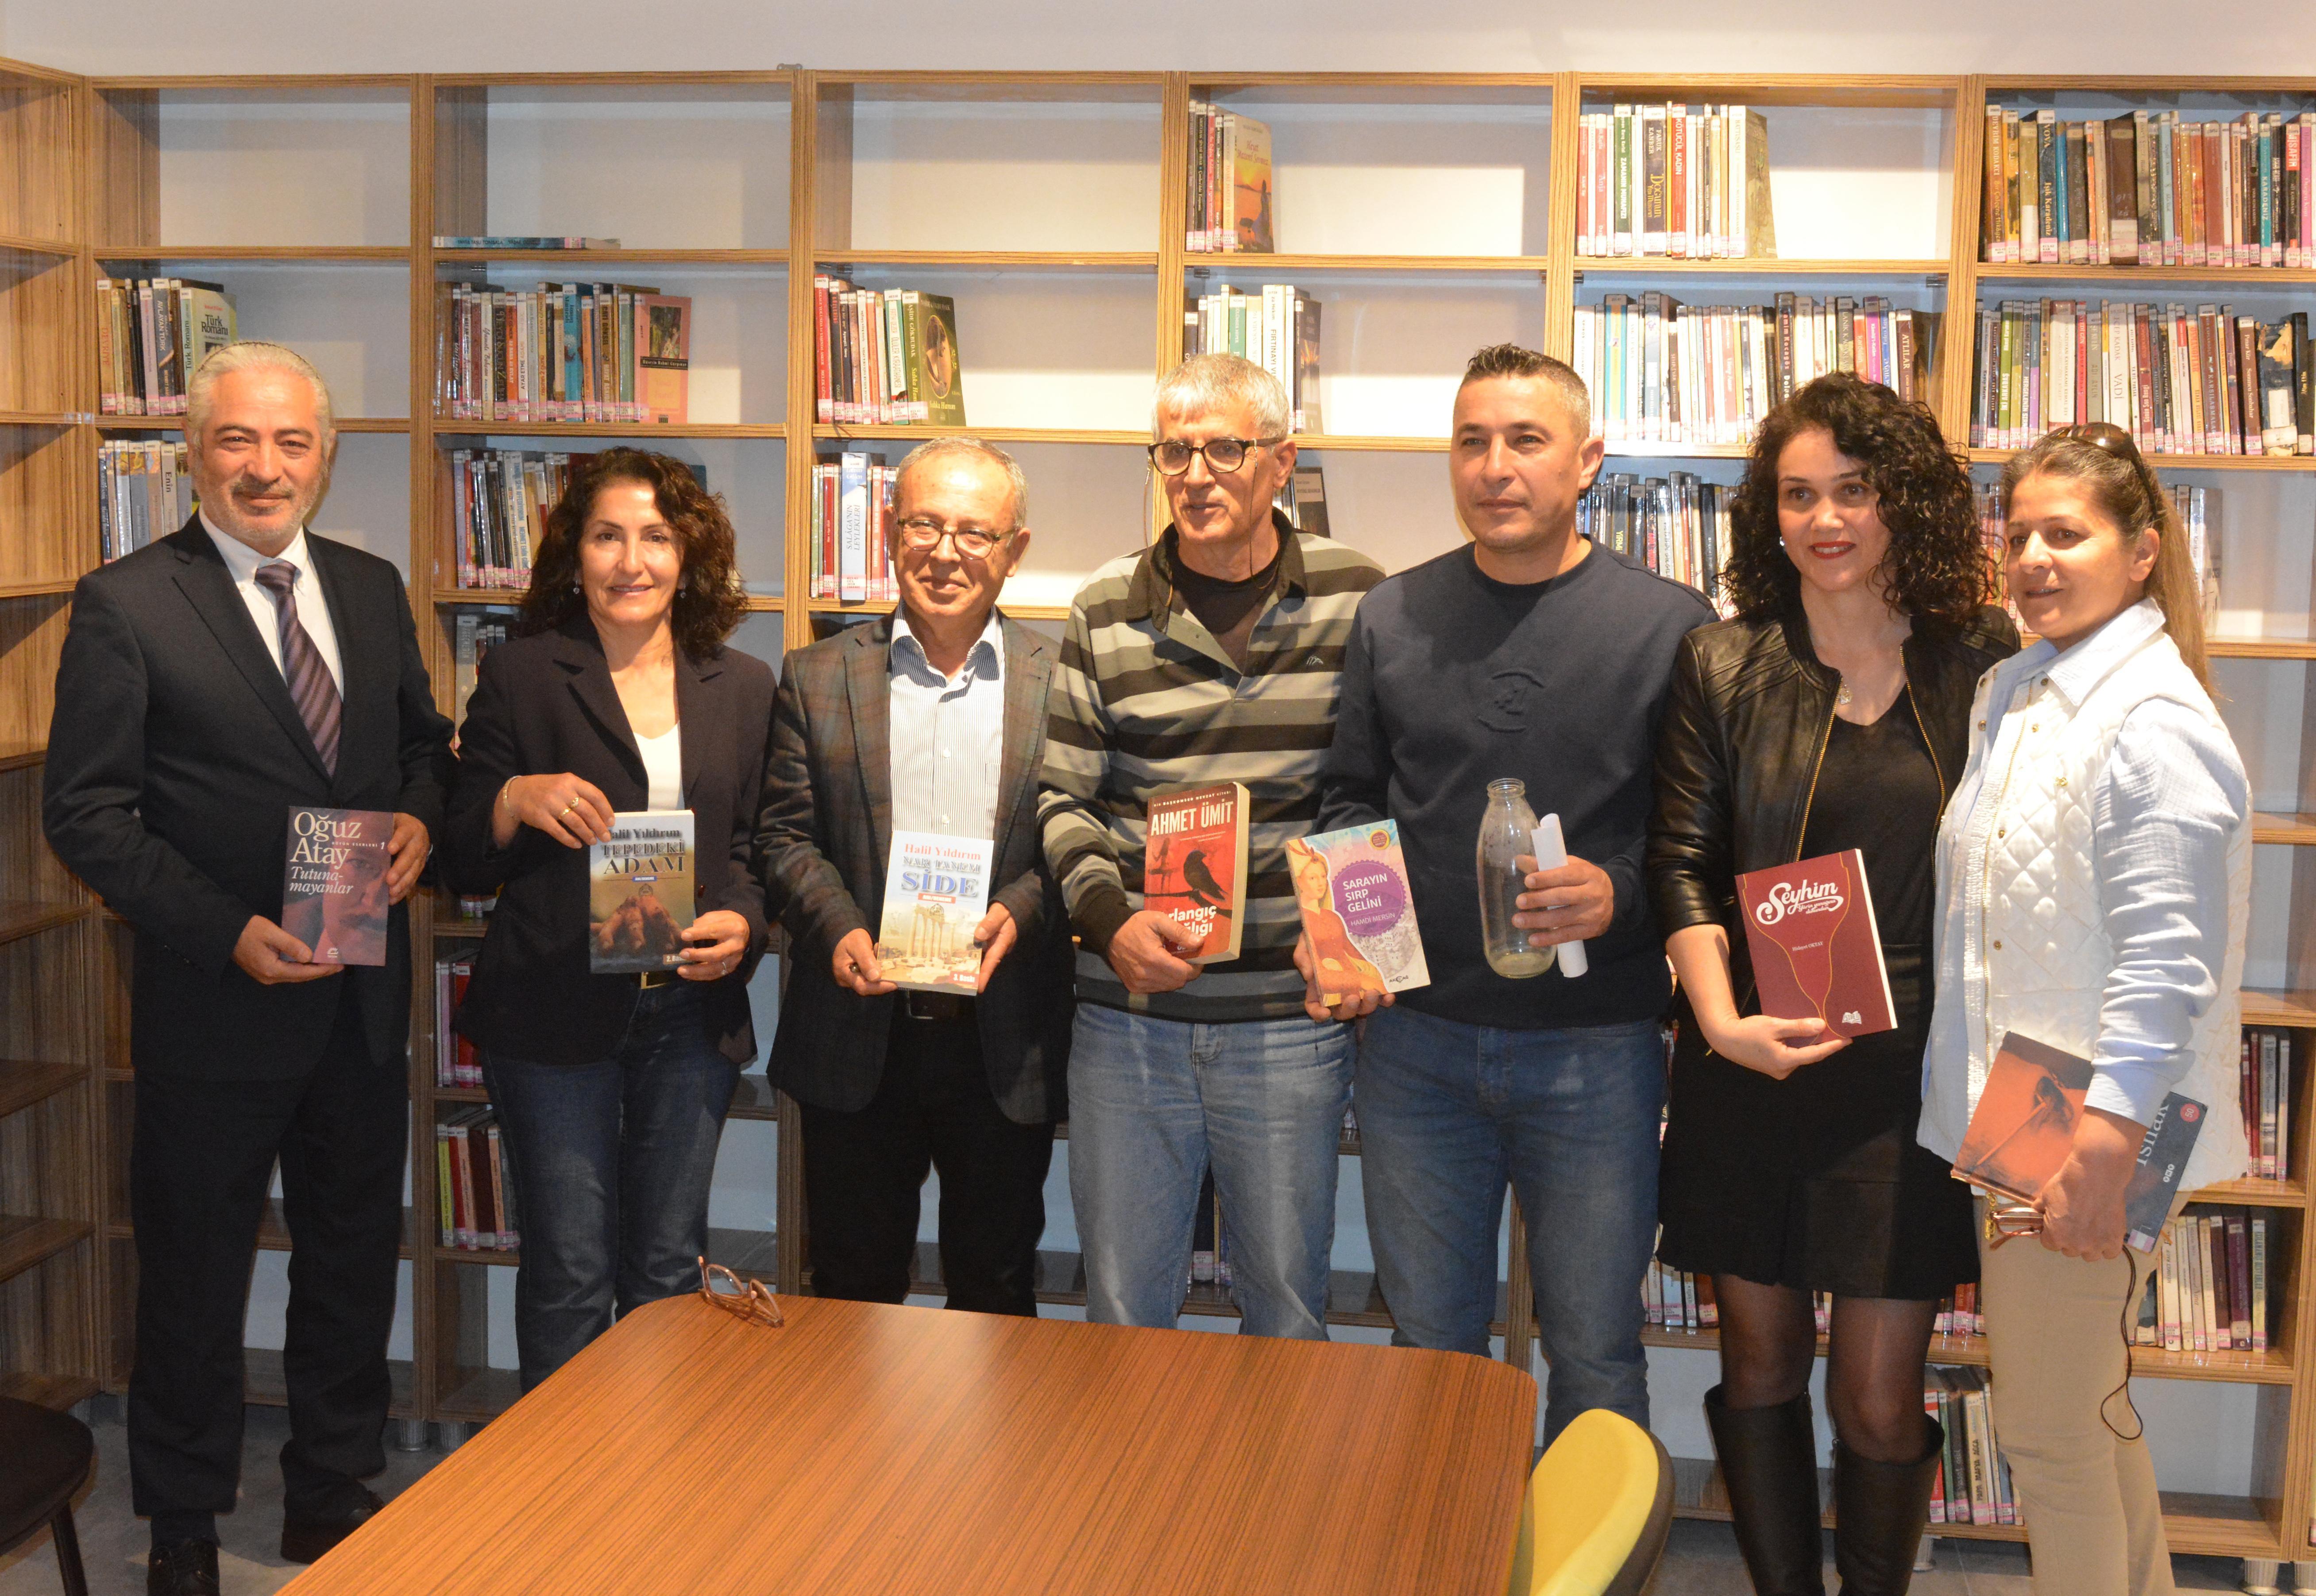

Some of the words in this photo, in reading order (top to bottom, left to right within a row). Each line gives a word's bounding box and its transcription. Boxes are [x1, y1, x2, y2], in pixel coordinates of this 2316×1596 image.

[205, 314, 223, 327] Türk
[2001, 373, 2010, 400] ARKADAŞ
[2114, 374, 2124, 399] VADİ
[1151, 808, 1197, 837] AHMET
[1200, 798, 1234, 828] ÜMİT
[294, 812, 362, 842] Oğuz
[633, 828, 680, 838] Yıldırım
[290, 837, 351, 869] Atay
[602, 839, 685, 856] TEPEDEKİ
[905, 844, 931, 856] Halil
[935, 847, 980, 860] Yıldırım
[604, 856, 685, 874] ADAM
[903, 856, 929, 867] NAR
[934, 859, 980, 873] TANEM
[291, 866, 344, 881] Tutuna-
[1343, 873, 1388, 890] SARAYIN
[289, 881, 354, 895] mayanlar
[901, 869, 978, 898] SİDE
[1345, 889, 1369, 902] SIRP
[1348, 895, 1382, 913] GELİNİ
[1351, 916, 1372, 927] HAMDİ
[1373, 912, 1395, 922] MERSİN
